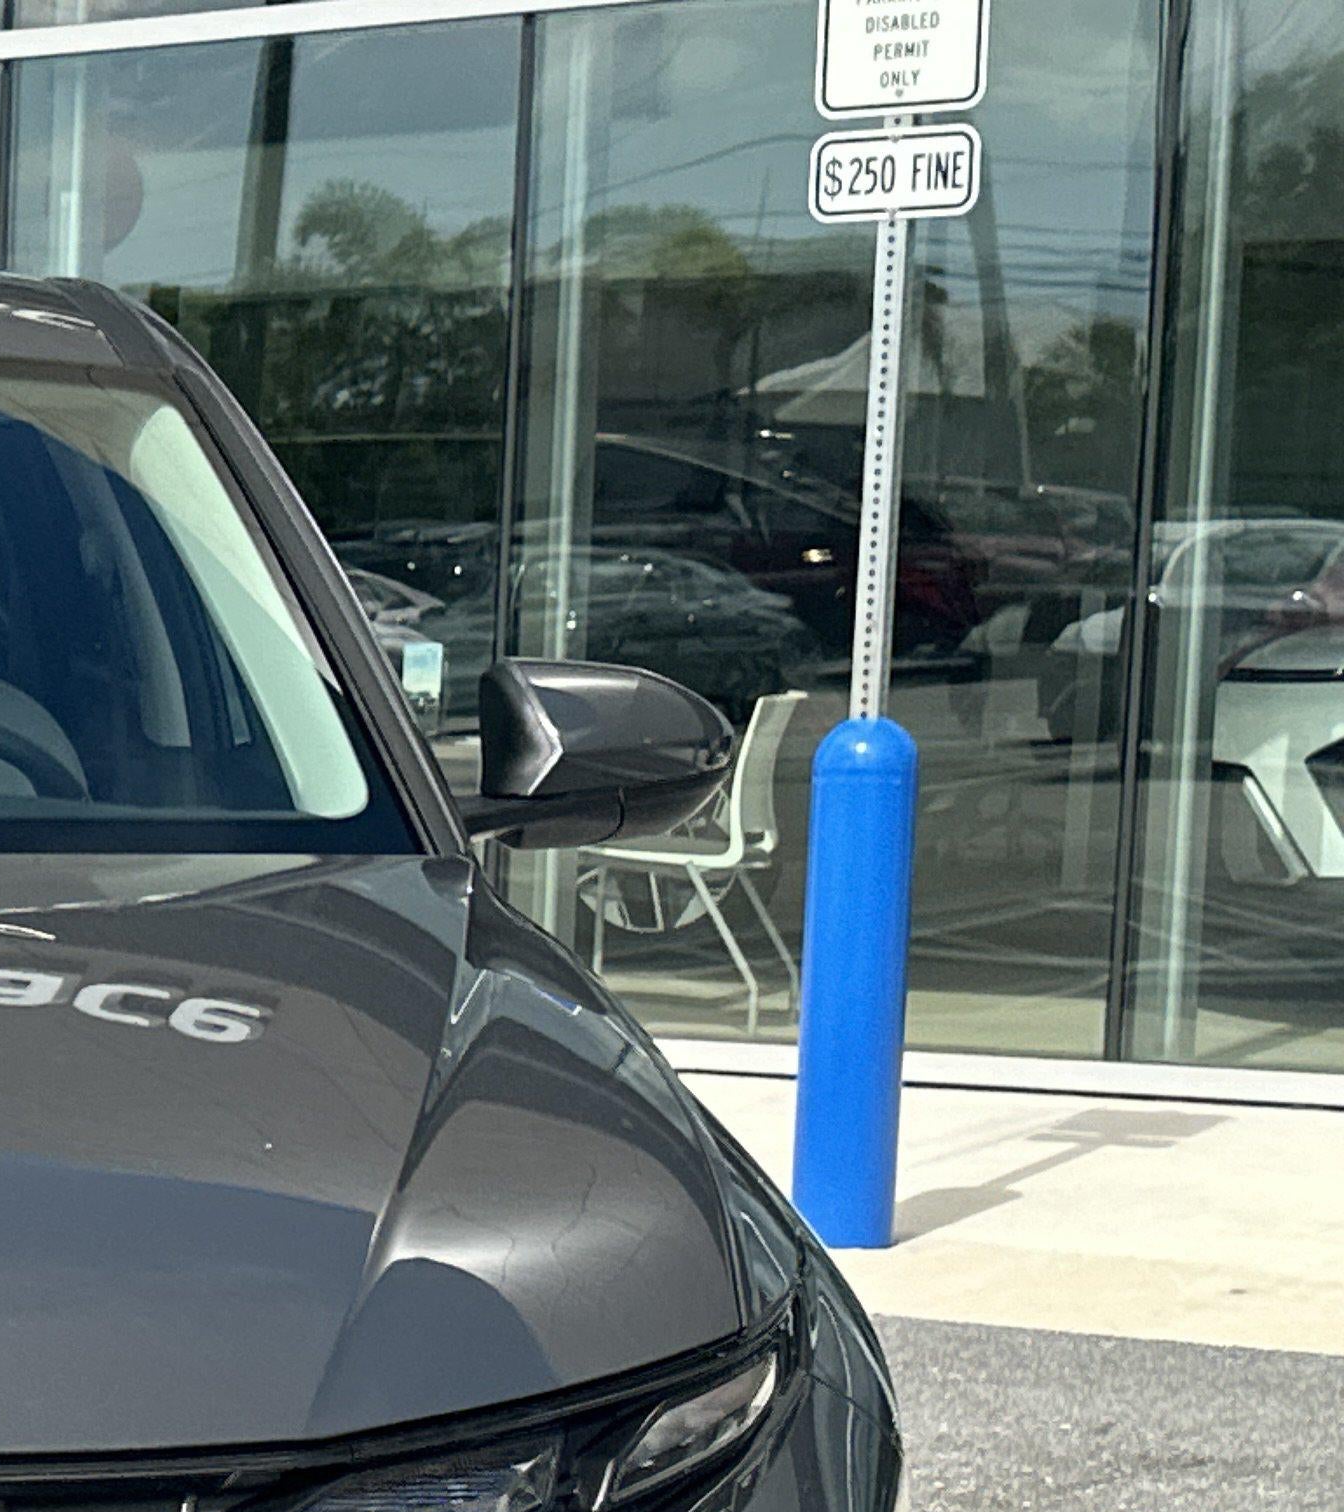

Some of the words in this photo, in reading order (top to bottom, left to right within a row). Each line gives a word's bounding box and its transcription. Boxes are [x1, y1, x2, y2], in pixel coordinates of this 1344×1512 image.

[865, 11, 940, 34] DISABLED
[873, 40, 930, 61] PERMIT
[879, 69, 921, 88] ONLY
[823, 154, 896, 201] $250
[911, 151, 966, 192] FINE
